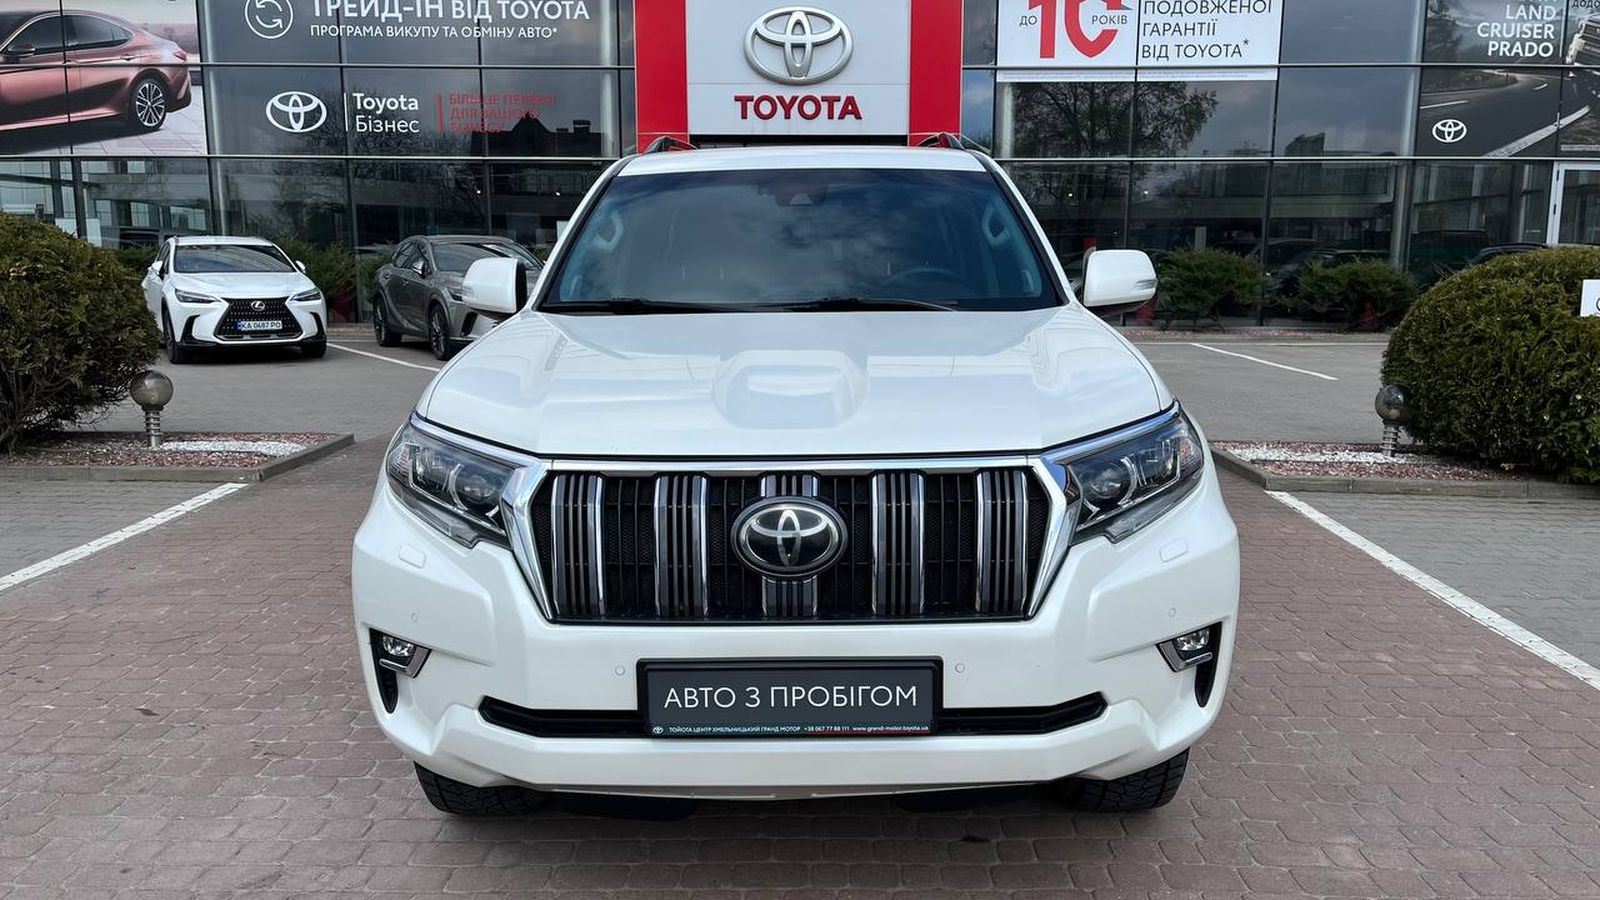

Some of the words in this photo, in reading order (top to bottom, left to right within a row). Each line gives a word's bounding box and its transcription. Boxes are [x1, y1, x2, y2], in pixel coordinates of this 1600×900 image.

[311, 0, 443, 22] ТРЕЙД-ІН
[452, 0, 492, 23] ВІД
[497, 1, 590, 20] TOYOTA
[1506, 4, 1556, 20] LAND
[1019, 15, 1038, 26] ДО
[1091, 15, 1128, 25] РОКІВ
[1143, 19, 1218, 36] ГАРАНТІЇ
[310, 25, 383, 37] ПРОГРАМА
[386, 26, 440, 37] ВИКУПУ
[442, 26, 458, 38] ТА
[461, 26, 514, 38] ОБМІНУ
[1477, 22, 1555, 39] CRUISER
[1142, 44, 1169, 61] ВІД
[1487, 41, 1554, 57] PRADO
[352, 92, 419, 115] Toyota
[734, 95, 862, 120] TOYOTA
[355, 115, 420, 133] Бізнес
[664, 687, 736, 708] АВТО
[745, 686, 761, 708] З
[770, 685, 917, 708] ПРОБІГОМ
